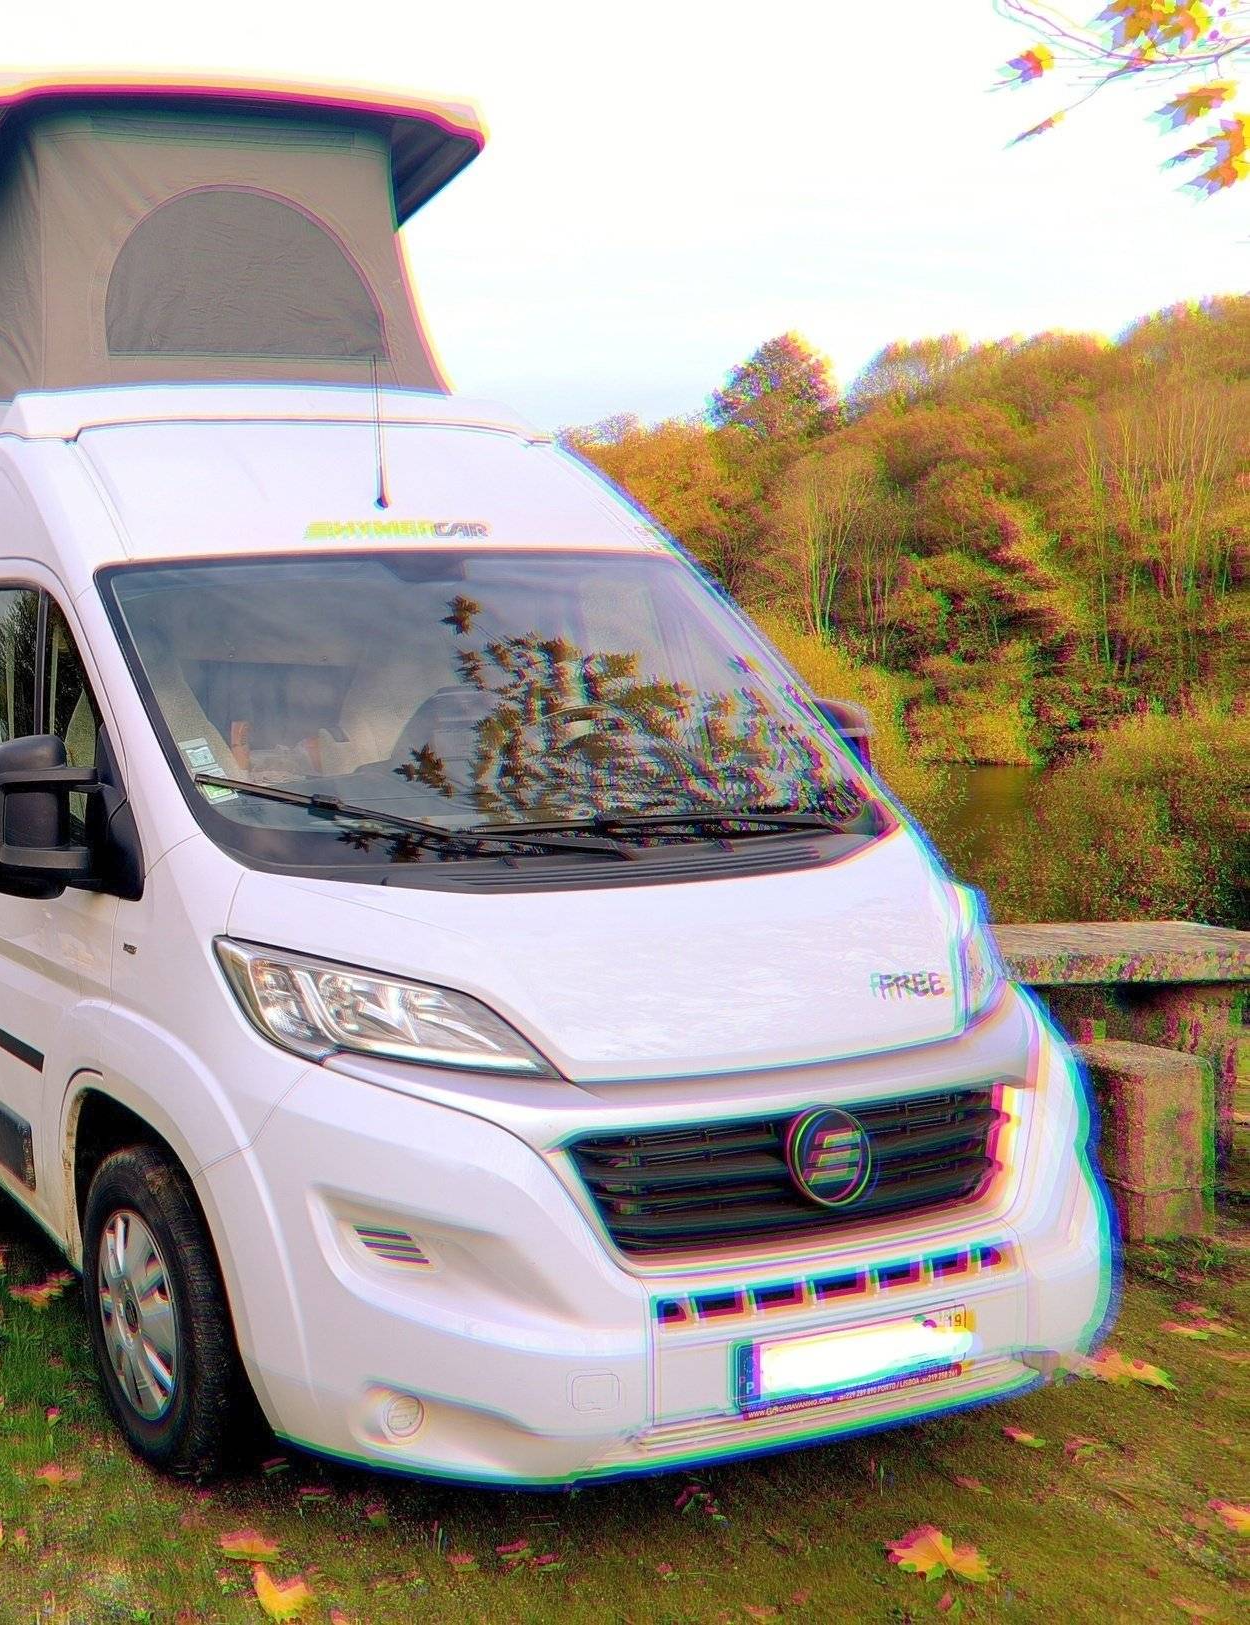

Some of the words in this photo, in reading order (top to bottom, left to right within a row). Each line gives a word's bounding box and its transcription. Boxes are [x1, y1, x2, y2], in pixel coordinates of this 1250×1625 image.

[877, 972, 945, 1000] FREE
[746, 1382, 755, 1394] P
[877, 1382, 895, 1392] PORTO
[899, 1376, 919, 1388] LISBOA
